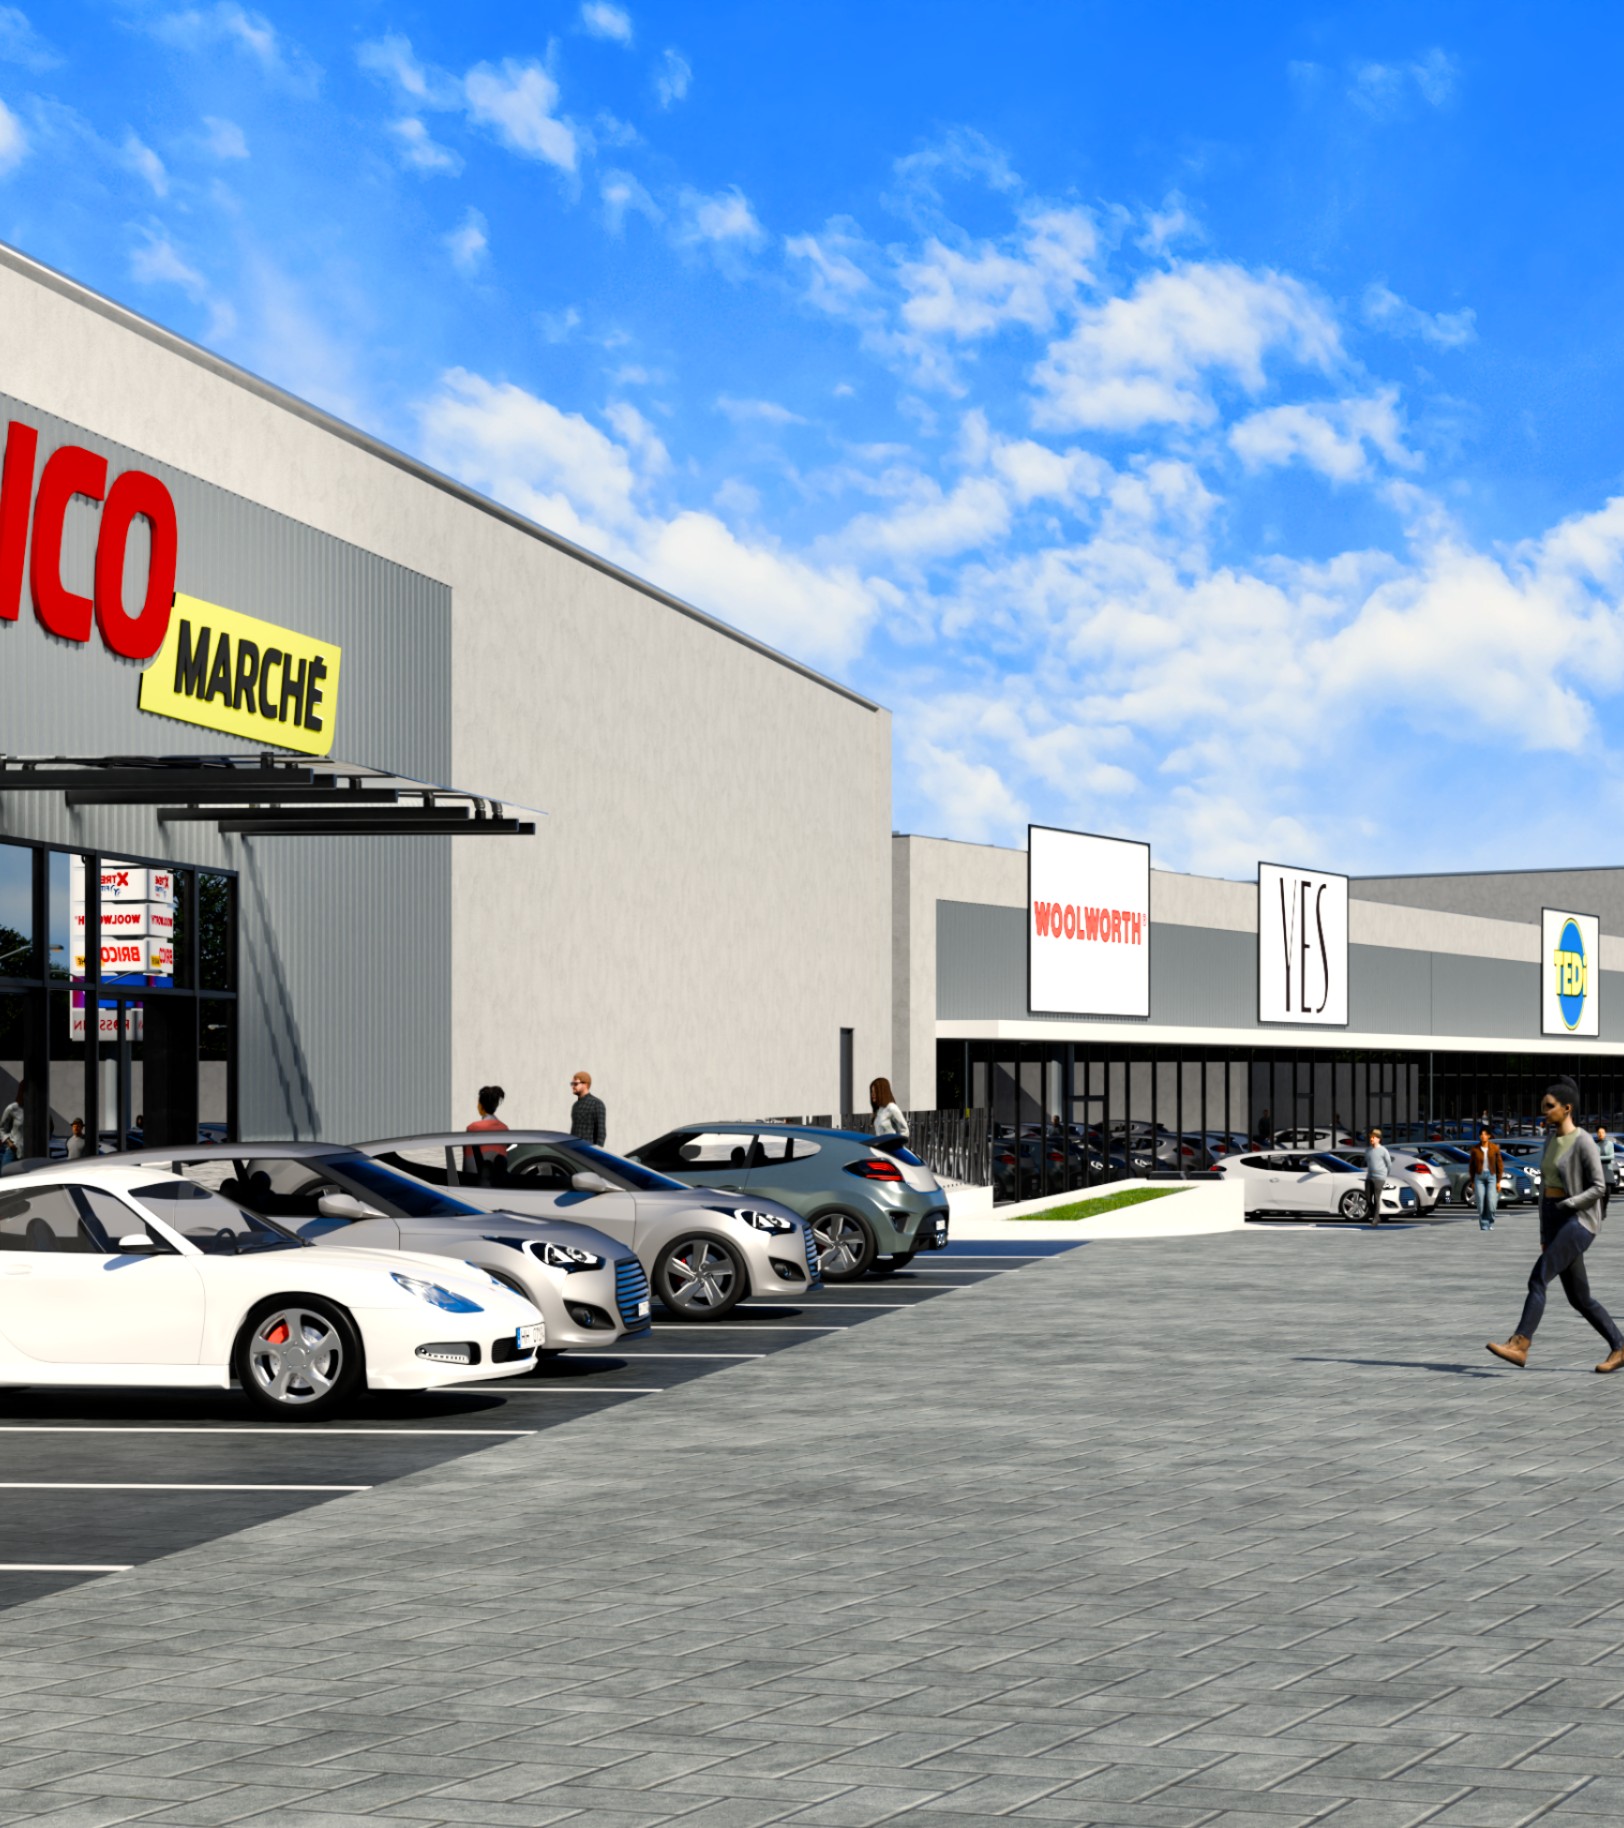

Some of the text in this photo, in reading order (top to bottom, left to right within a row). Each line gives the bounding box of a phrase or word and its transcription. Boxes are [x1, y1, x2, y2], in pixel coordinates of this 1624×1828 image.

[174, 619, 327, 732] MARCHÉ
[1034, 900, 1142, 945] WOOLWORTH
[1279, 877, 1329, 1014] YES
